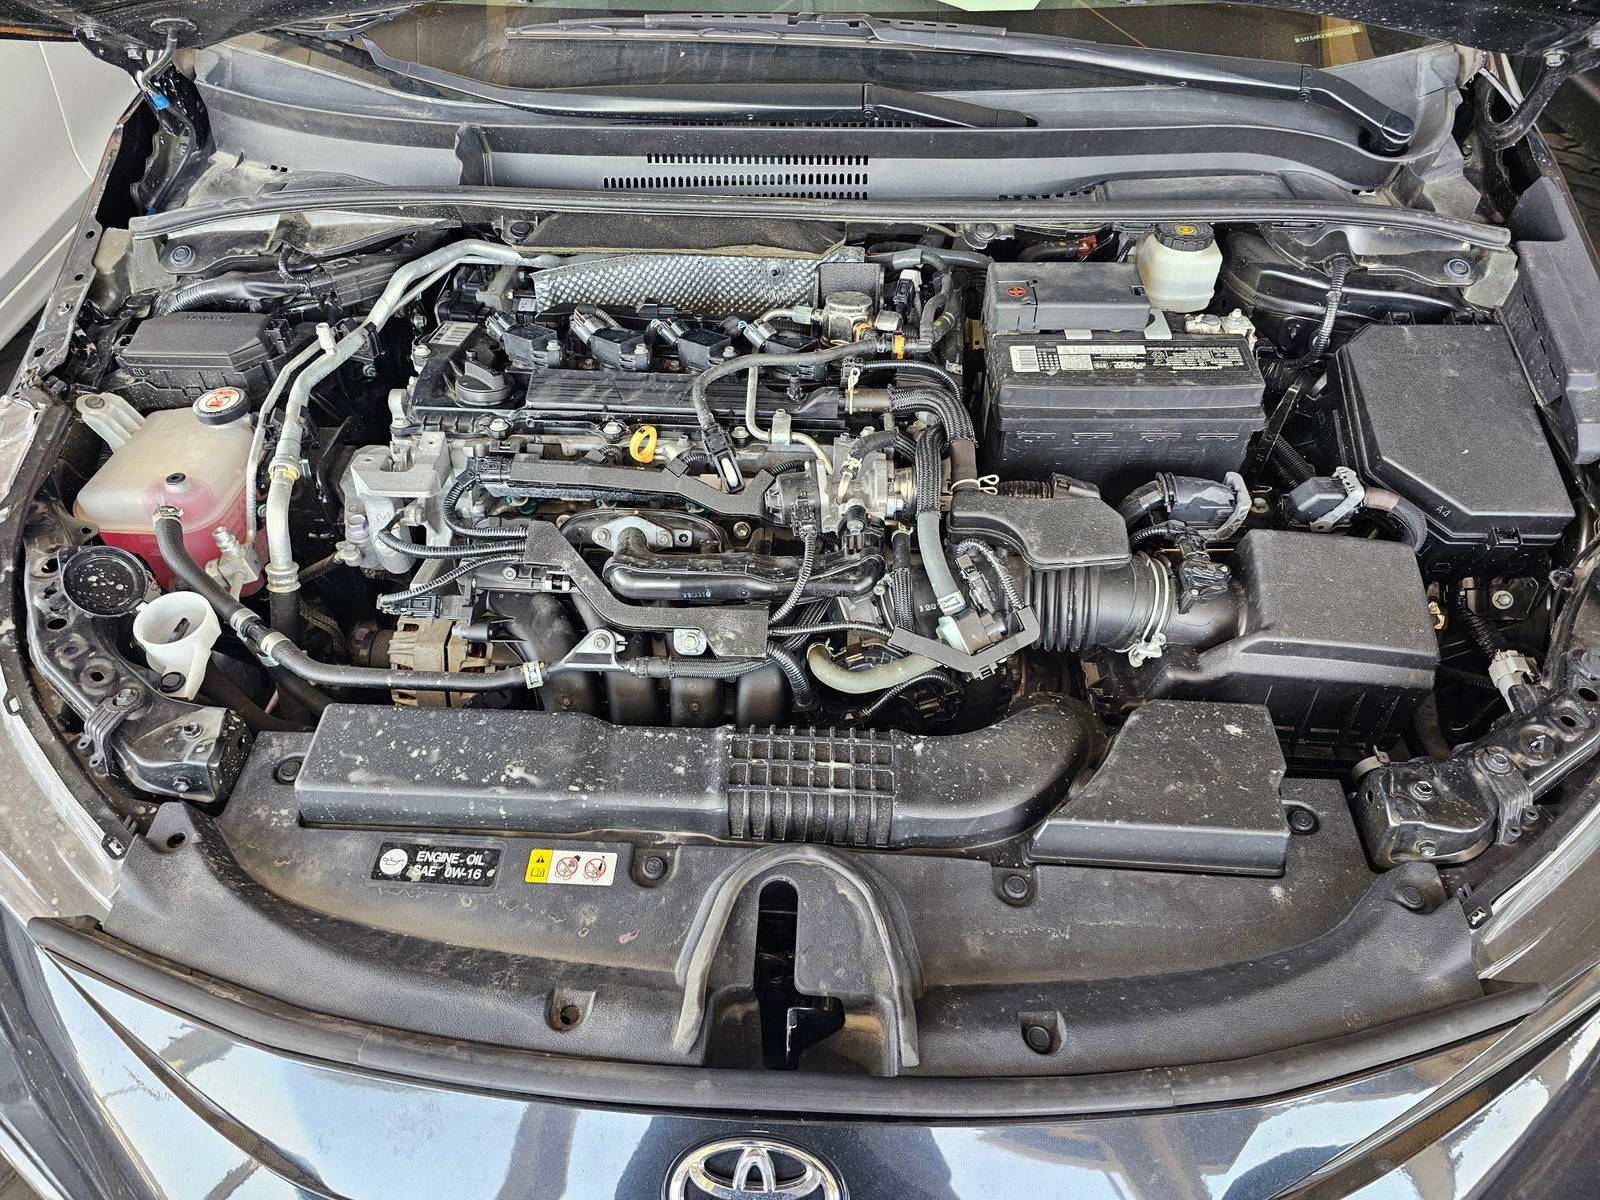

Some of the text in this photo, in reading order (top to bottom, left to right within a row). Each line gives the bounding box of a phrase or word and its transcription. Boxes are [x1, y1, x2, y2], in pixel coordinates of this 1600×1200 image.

[416, 851, 485, 866] ENGINE OIL
[413, 865, 482, 880] SAE 0W-16
